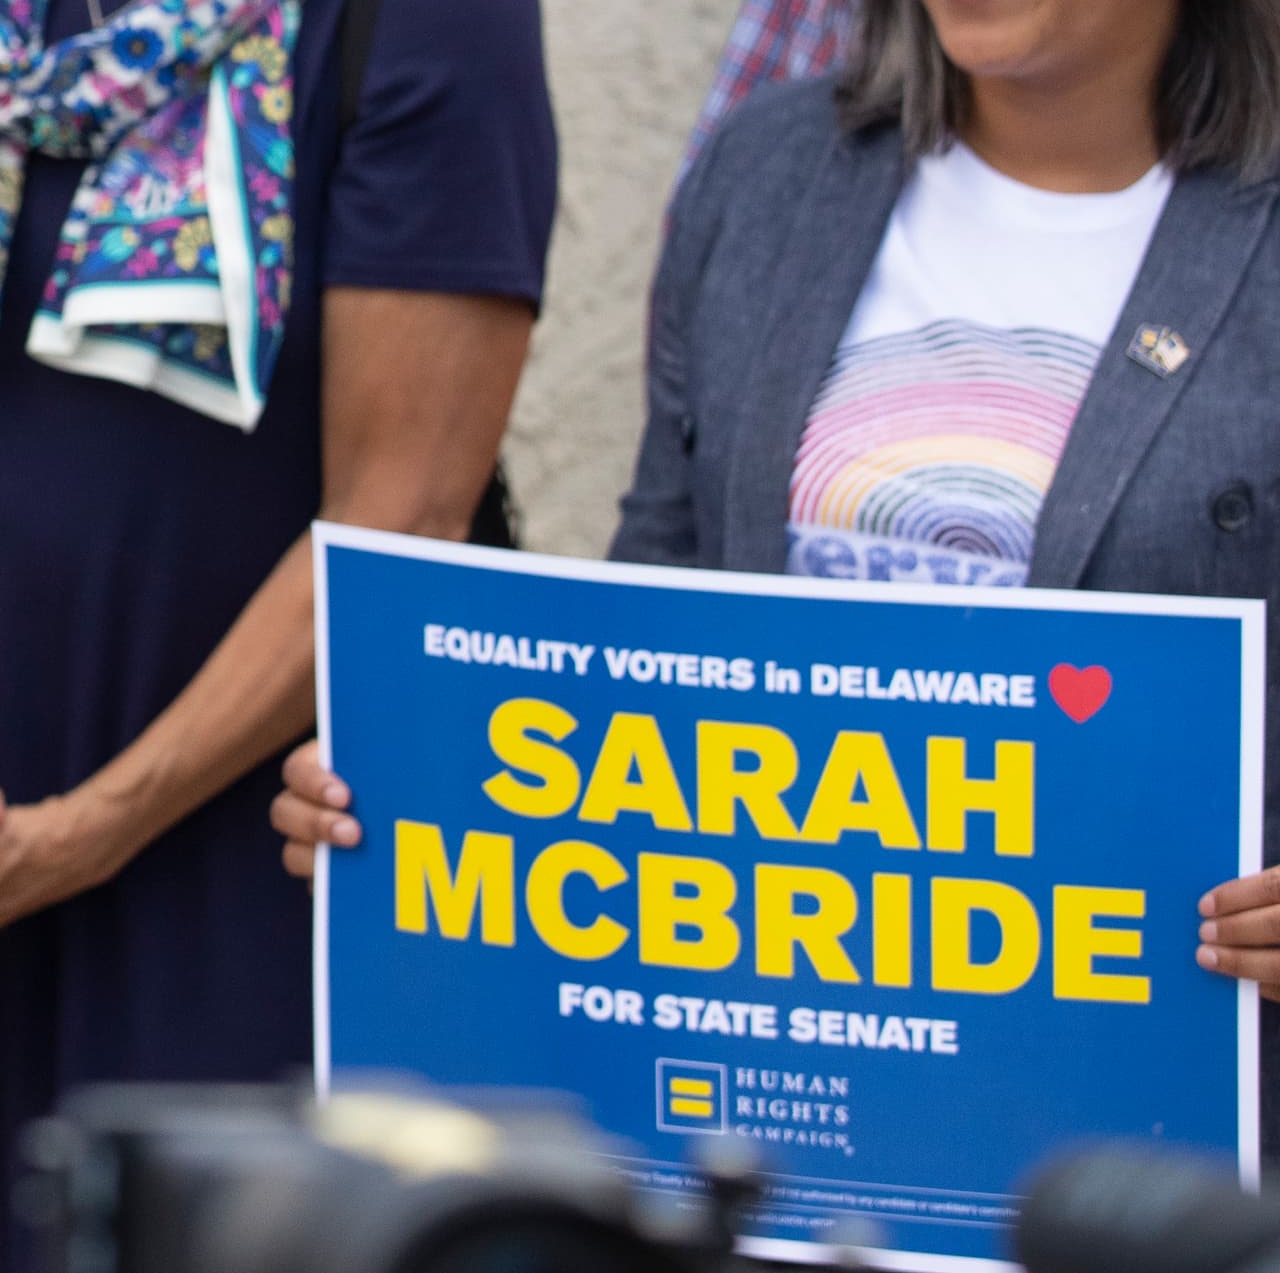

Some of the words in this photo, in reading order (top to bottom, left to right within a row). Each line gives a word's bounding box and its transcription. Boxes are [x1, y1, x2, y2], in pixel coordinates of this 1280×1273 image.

[424, 623, 595, 676] EQUALITY
[603, 647, 756, 692] VOTERS
[764, 660, 802, 695] in
[810, 662, 1037, 708] DELAWARE
[481, 696, 1036, 858] SARAH
[393, 818, 1152, 1005] MCBRIDE
[558, 981, 645, 1026] FOR
[652, 992, 779, 1041] STATE
[788, 1006, 960, 1056] SENATE
[735, 1066, 851, 1098] HUMAN
[735, 1094, 851, 1127] RIGHTS
[734, 1121, 851, 1149] CAMPAIGN
